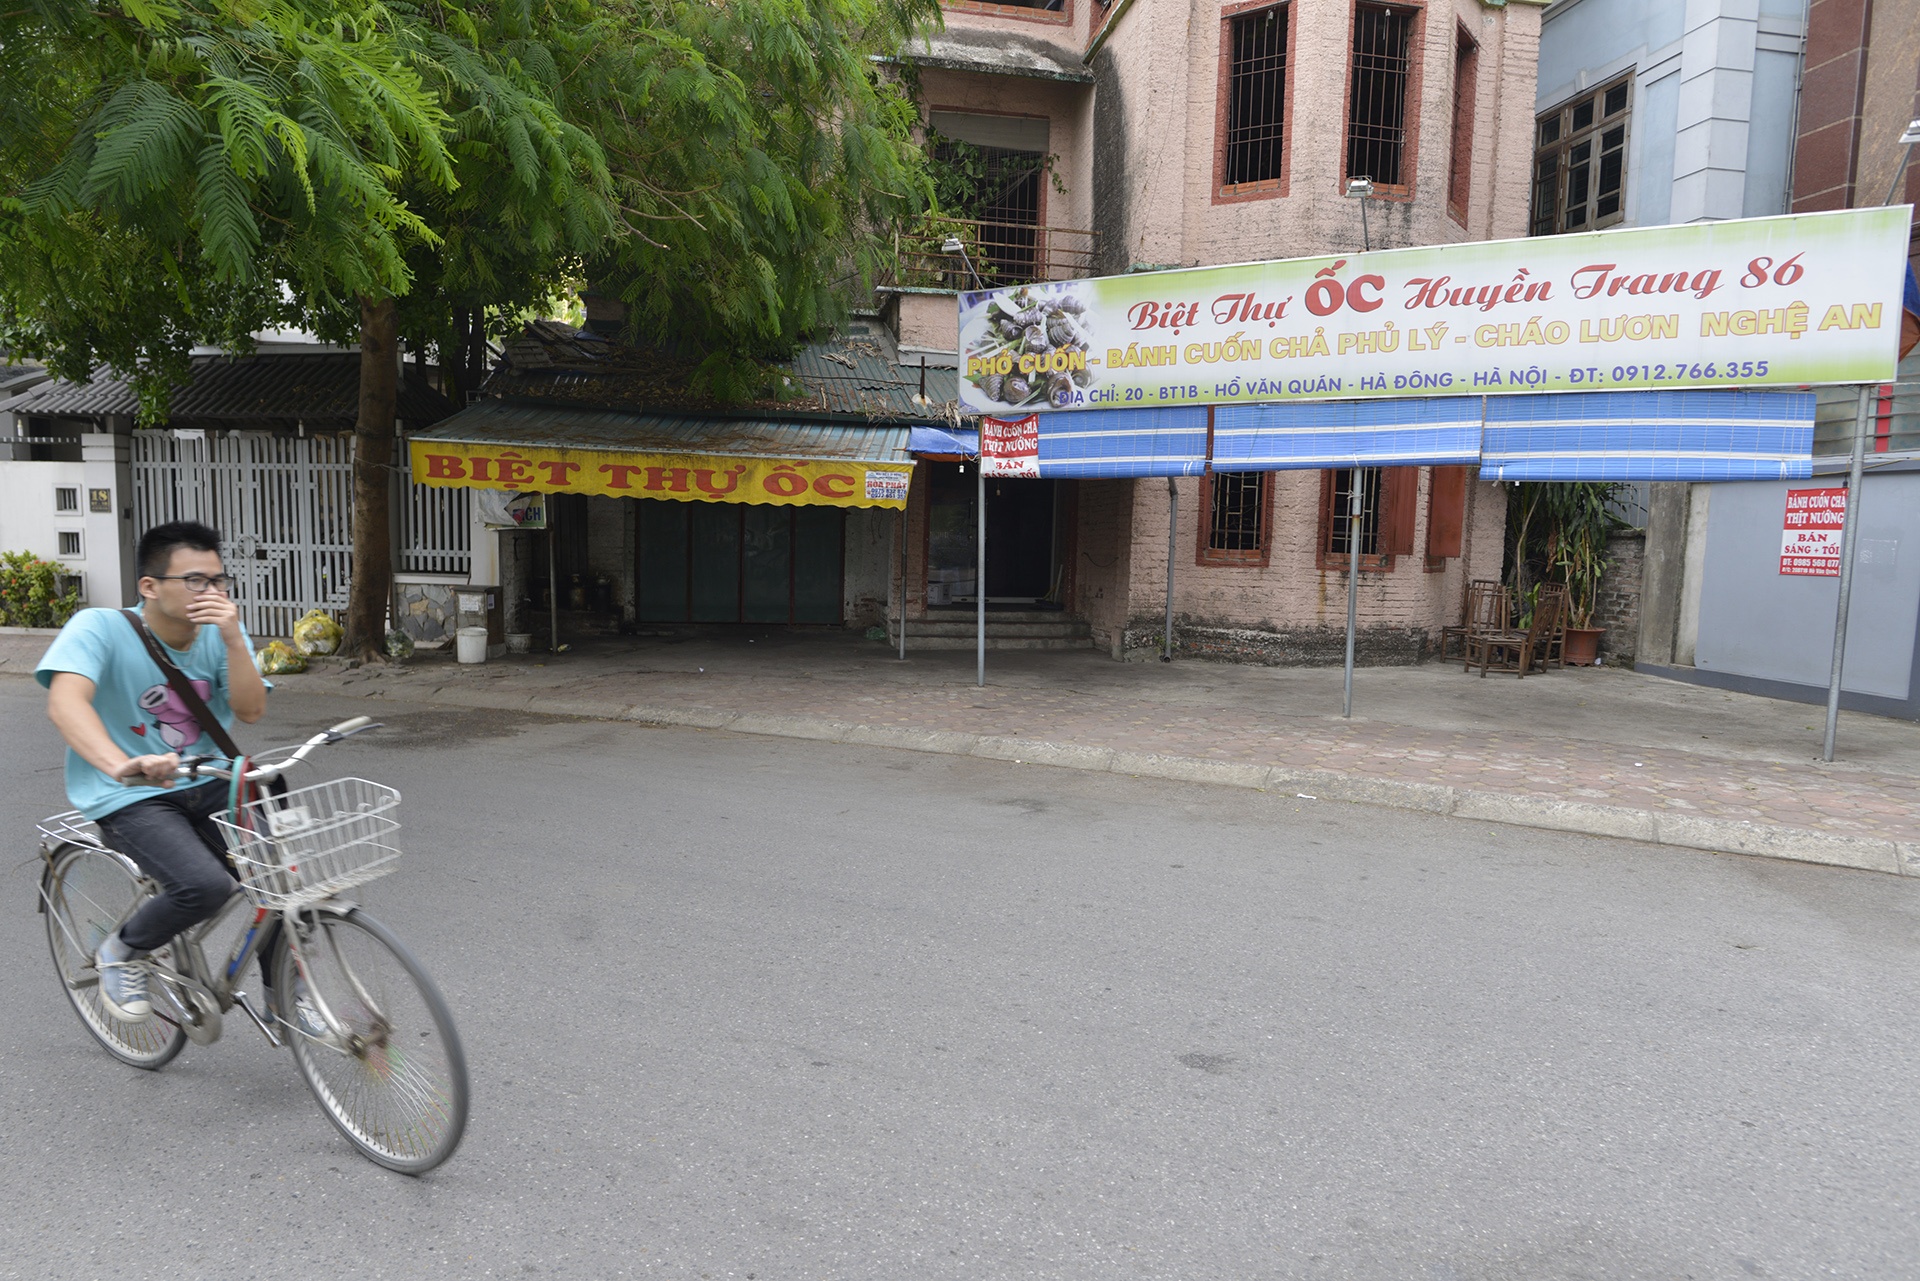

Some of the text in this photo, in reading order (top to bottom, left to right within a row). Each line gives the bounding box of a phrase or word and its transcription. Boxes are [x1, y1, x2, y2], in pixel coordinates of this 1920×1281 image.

[1128, 251, 1806, 335] Biệt Thự ỐC Huyền Trang 86
[967, 348, 1013, 377] PHỞ
[1018, 342, 1086, 374] CUỐN
[1106, 342, 1177, 369] BÁNH
[1184, 331, 1262, 364] CUỐN
[1270, 327, 1330, 359] CHẢ
[1338, 320, 1400, 354] PHỦ
[1408, 320, 1450, 350] LÝ
[1474, 315, 1571, 348] CHÁO
[1579, 311, 1680, 344] LƯƠN
[1700, 300, 1810, 339] NGHỆ
[1817, 302, 1883, 331] AN
[1089, 384, 1119, 403] CHỈ:
[1125, 387, 1143, 401] 20
[1159, 385, 1198, 400] BT1B
[1215, 375, 1241, 397] HỒ
[1246, 377, 1283, 395] VĂN
[1288, 375, 1342, 394] QUÁN
[1361, 371, 1387, 390] HÀ
[1393, 370, 1453, 389] ĐÔNG
[1473, 366, 1503, 387] HÀ
[1509, 365, 1547, 388] NỘI
[1569, 367, 1604, 385] ĐT:
[1611, 360, 1768, 382] 0912.766.355
[984, 421, 1003, 437] BÁNH
[1023, 416, 1038, 434] CHẢ
[425, 452, 856, 499] BIỆT THỰ ỐC
[91, 490, 108, 501] 18
[1788, 490, 1846, 509] BÁNH CUỐN CHẢ
[1797, 531, 1828, 542] BÁN
[1784, 543, 1811, 554] SÁNG
[1822, 542, 1840, 555] TỐI
